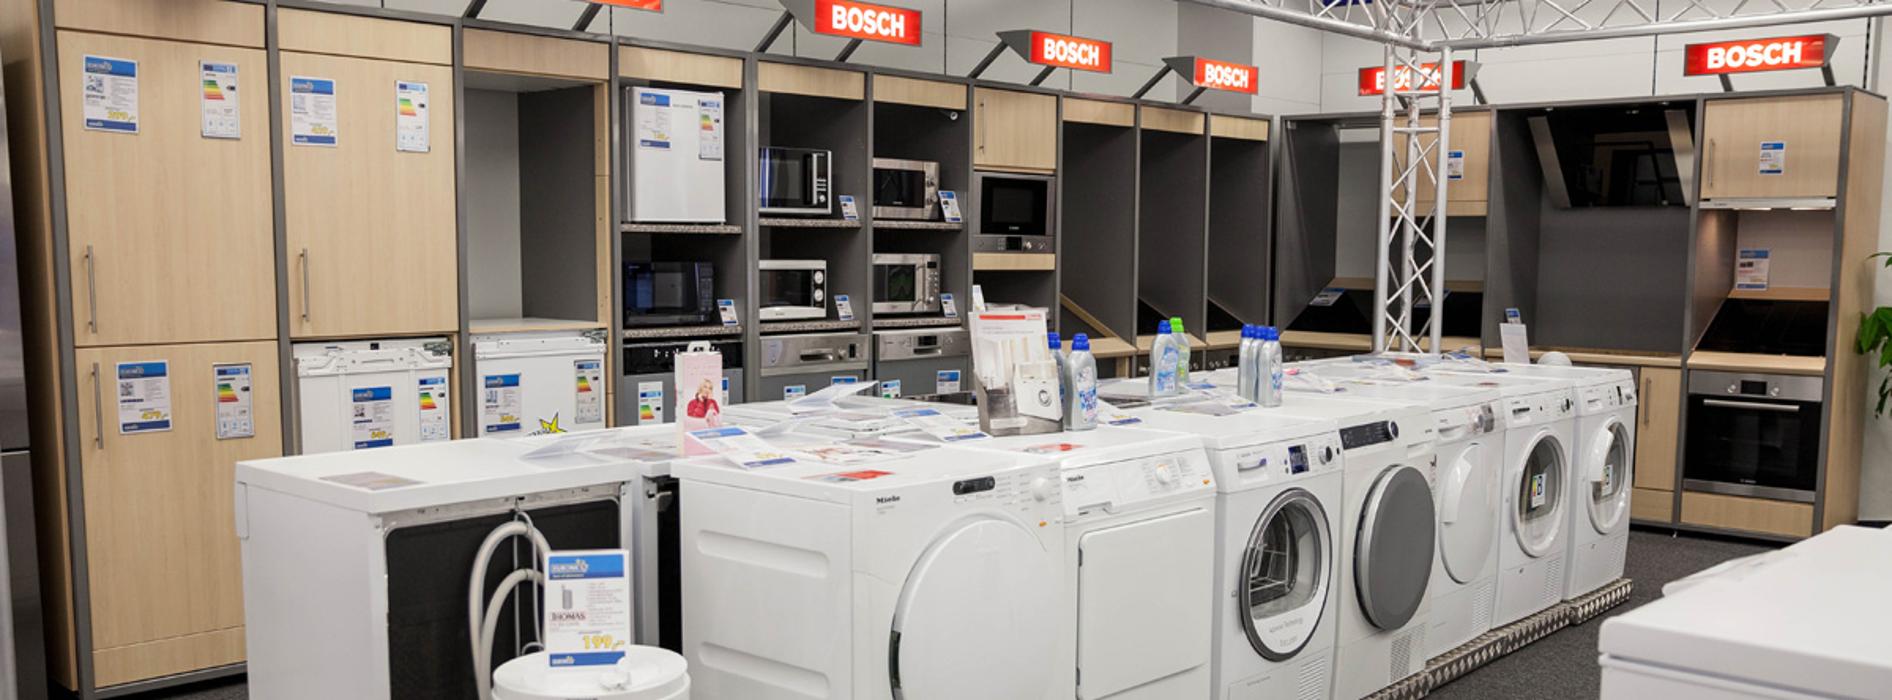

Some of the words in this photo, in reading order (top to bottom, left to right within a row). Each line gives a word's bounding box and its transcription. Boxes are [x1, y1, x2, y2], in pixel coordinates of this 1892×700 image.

[831, 4, 905, 38] BOSCH
[1043, 37, 1100, 67] BOSCH
[1707, 41, 1802, 68] BOSCH
[1204, 63, 1249, 88] BOSCH
[876, 495, 900, 504] Miele
[551, 612, 586, 621] THOMAS
